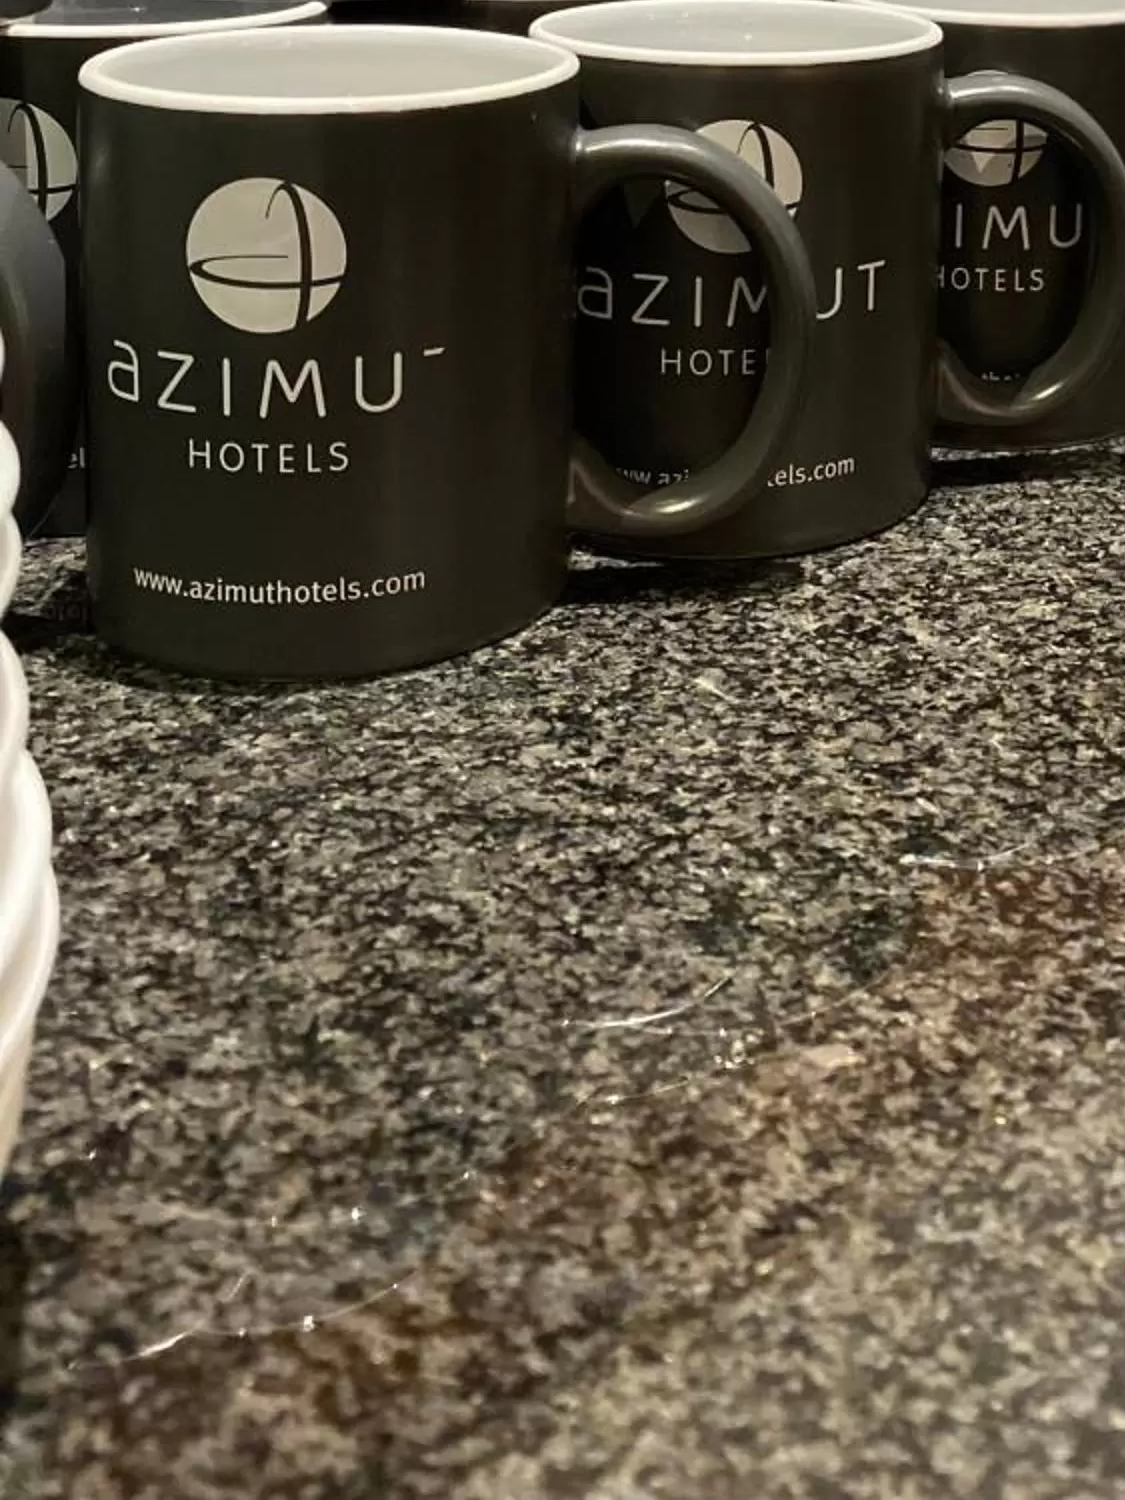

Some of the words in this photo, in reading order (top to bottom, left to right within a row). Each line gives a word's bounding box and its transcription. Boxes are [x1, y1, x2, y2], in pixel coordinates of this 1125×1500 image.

[660, 347, 770, 376] HOTE
[188, 438, 350, 474] HOTELS
[133, 567, 426, 604] www.azimuthotels.com
